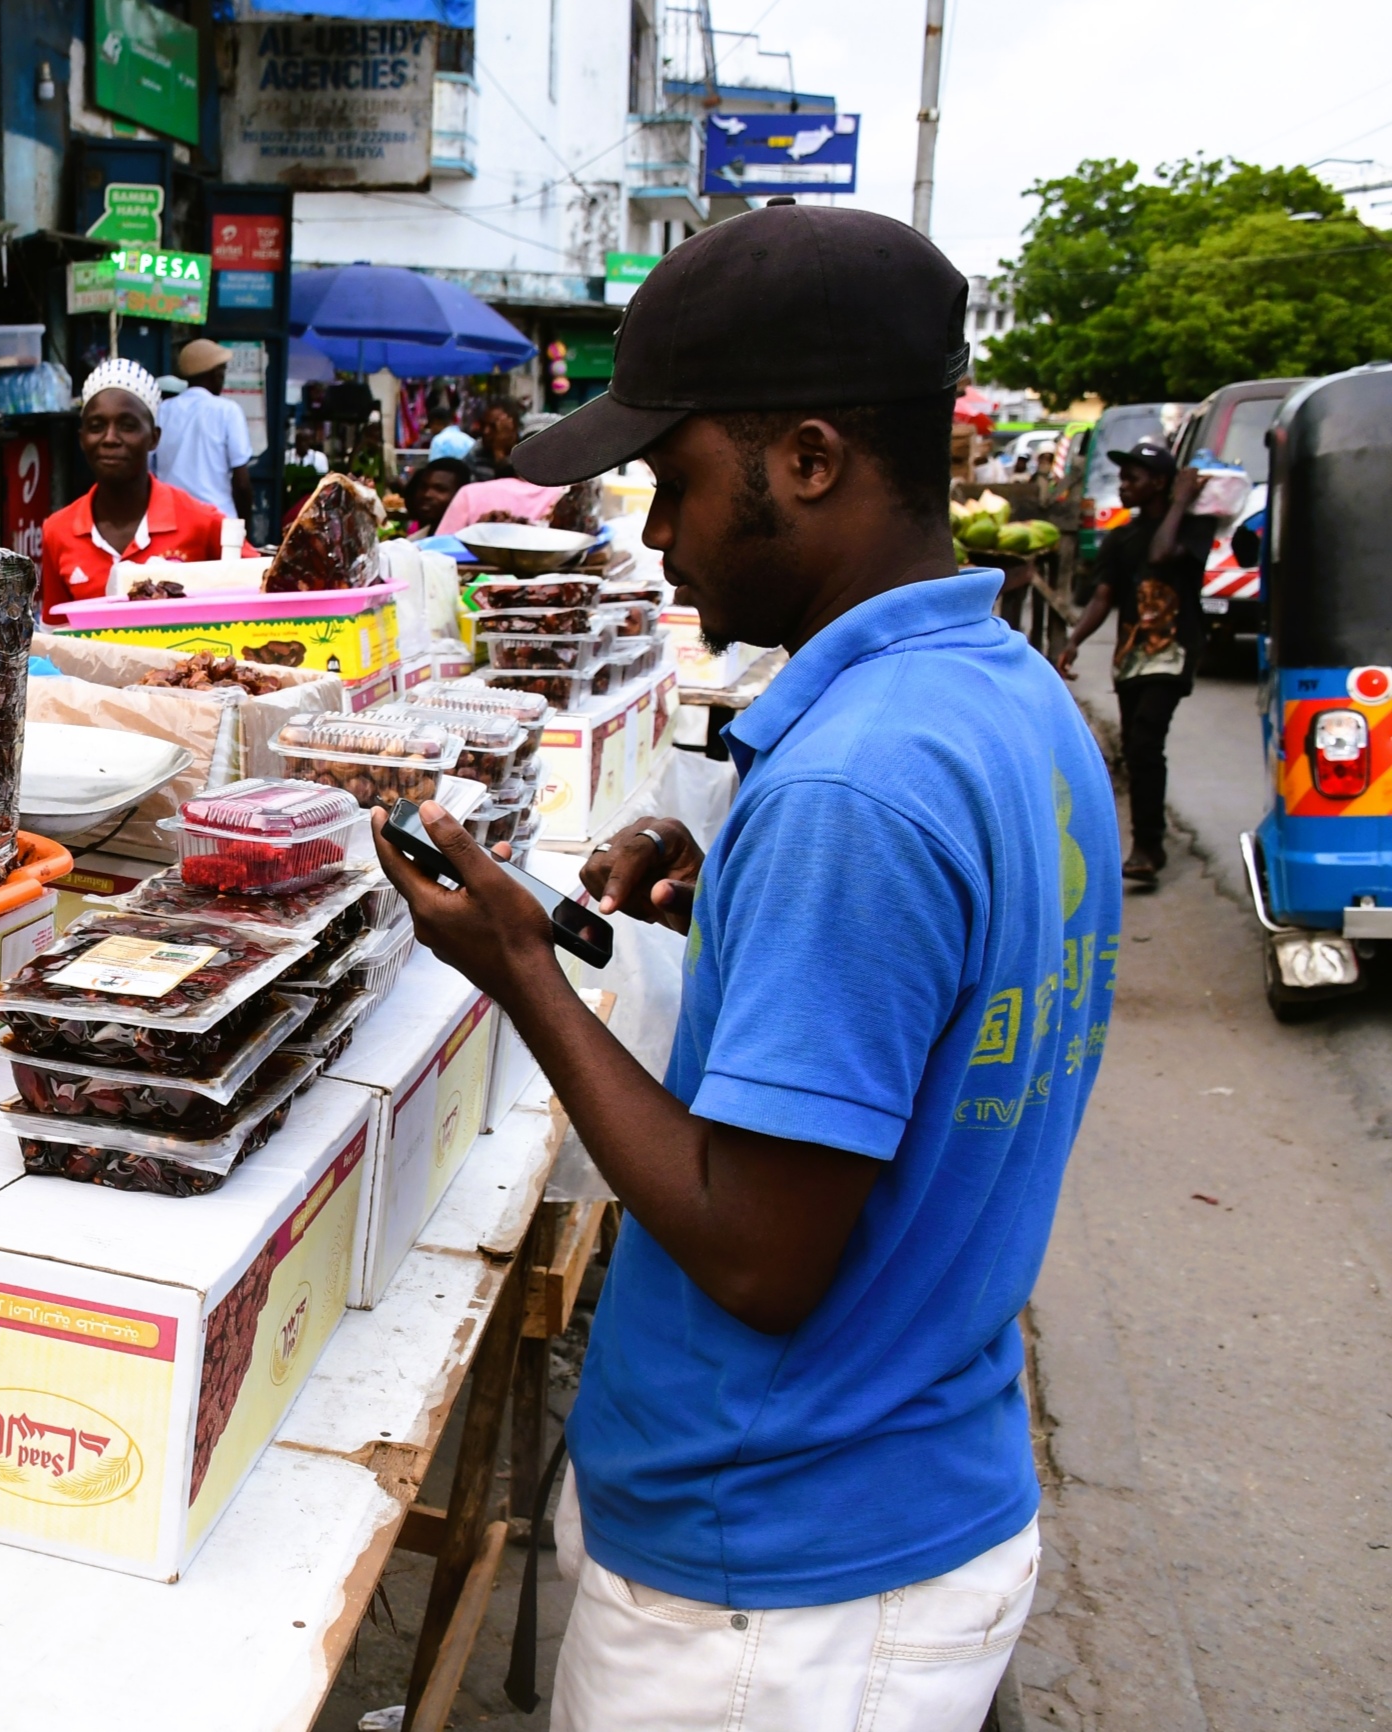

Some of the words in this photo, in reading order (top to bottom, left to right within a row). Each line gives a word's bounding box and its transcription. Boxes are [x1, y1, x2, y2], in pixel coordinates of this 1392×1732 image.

[259, 58, 408, 90] AGENCIES
[116, 204, 150, 217] HAPA
[252, 249, 281, 260] HERE
[128, 290, 185, 315] SHOP
[75, 875, 108, 889] Natural
[76, 1318, 140, 1342] طبيعية
[18, 1444, 65, 1477] Saad
